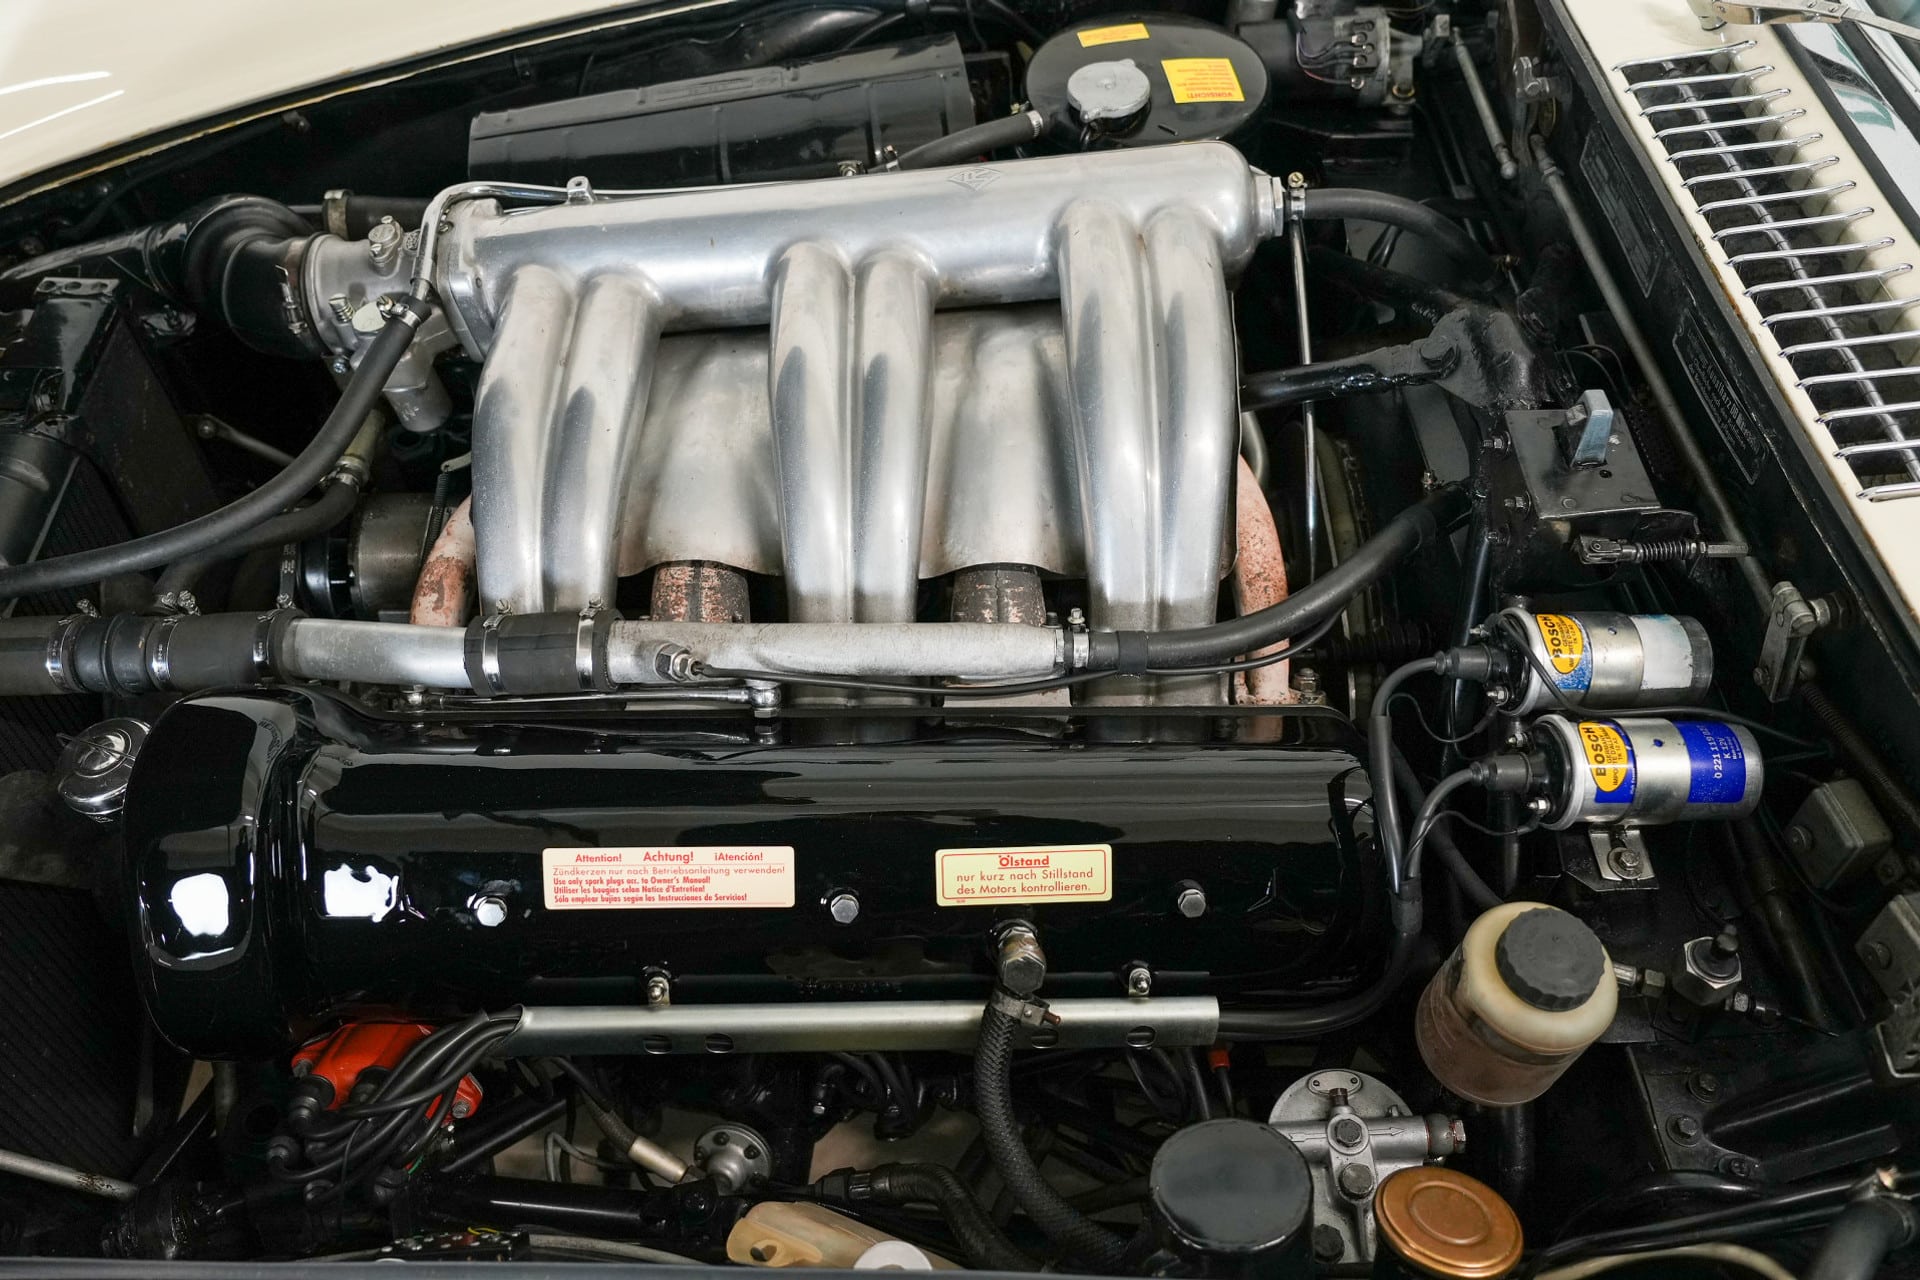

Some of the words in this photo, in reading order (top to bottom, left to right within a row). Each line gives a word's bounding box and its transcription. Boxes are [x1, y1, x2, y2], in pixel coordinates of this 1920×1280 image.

[1539, 615, 1562, 658] BOSCH
[1706, 736, 1719, 751] 119
[1717, 737, 1729, 751] 12V
[1582, 727, 1606, 776] BOSCH
[1712, 754, 1722, 770] 221
[575, 853, 622, 863] Attention!
[643, 851, 694, 864] Achtung!
[999, 855, 1050, 867] Ölstand
[553, 867, 606, 876] Zündkerzen
[627, 866, 649, 875] nach
[652, 866, 730, 876] Betriebsanleitung
[733, 866, 785, 875] verwenden!
[956, 873, 975, 883] nur
[979, 871, 1005, 881] kurz
[1009, 870, 1037, 880] nach
[1042, 868, 1094, 879] Stillstand
[568, 877, 583, 886] only
[585, 877, 604, 886] spark
[606, 876, 625, 886] plugs
[650, 876, 680, 884] Owner's
[682, 876, 711, 884] Manual!
[554, 886, 579, 894] Utiliser
[580, 886, 591, 894] les
[593, 885, 619, 895] bougies
[622, 885, 640, 893] selon
[642, 885, 664, 893] Notice
[957, 885, 975, 895] des
[979, 884, 1017, 894] Motors
[1021, 882, 1091, 893] kontrollieren.
[571, 894, 598, 903] emplear
[658, 893, 702, 902] Instrucciones
[704, 893, 713, 901] de
[714, 893, 747, 901] Servicios!
